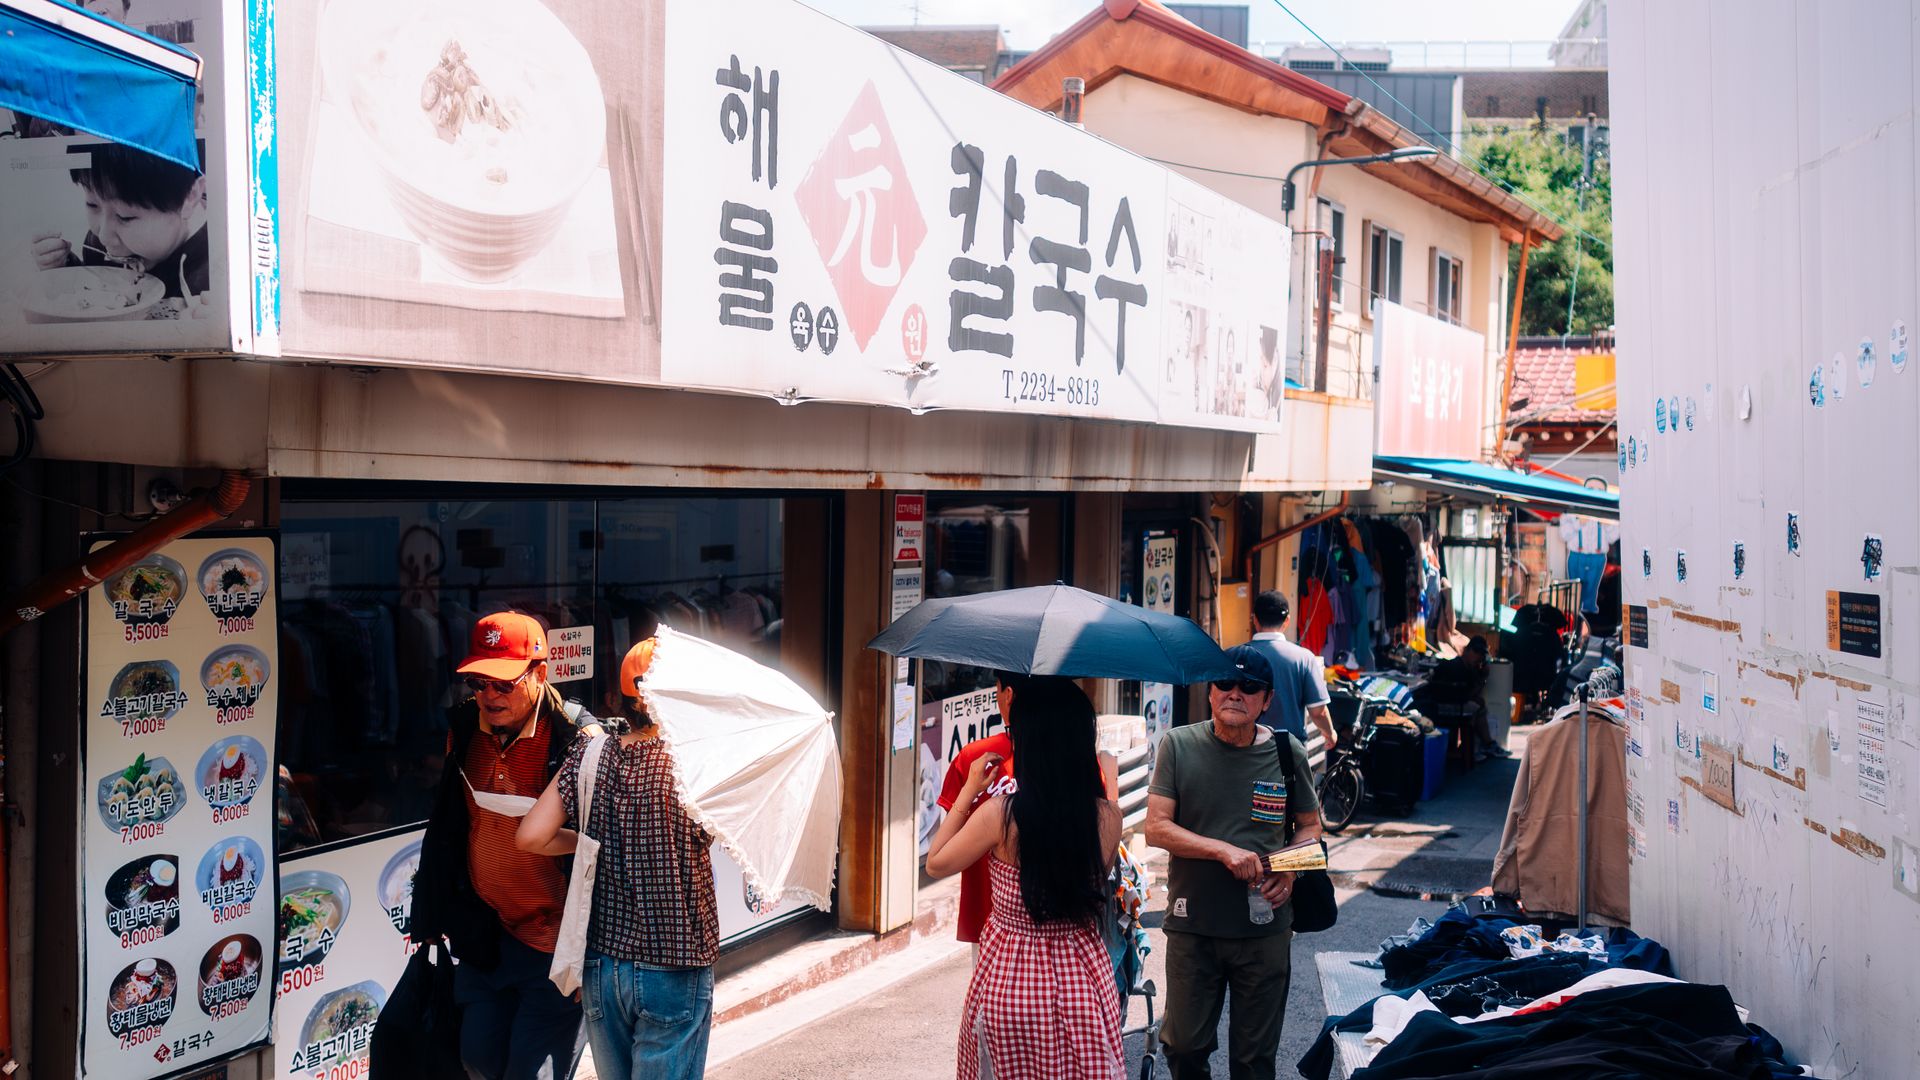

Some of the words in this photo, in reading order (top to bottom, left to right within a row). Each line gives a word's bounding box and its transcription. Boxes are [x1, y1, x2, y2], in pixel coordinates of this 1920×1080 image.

[715, 54, 780, 331] 해물
[948, 141, 1148, 375] 칼국수
[114, 598, 176, 619] 칼국수
[207, 591, 260, 612] 떡만두국
[125, 624, 169, 644] 5,500원
[217, 618, 254, 636] 7,000원
[101, 691, 188, 717] 소불고기칼국수
[207, 683, 260, 708] 손수제비
[216, 706, 254, 725] 6,000원
[122, 719, 165, 739] 7,000원
[204, 778, 257, 804] 냉칼국수
[109, 793, 173, 820] 이도만두
[213, 804, 249, 824] 6,000원
[121, 823, 164, 844] 7,000원
[202, 880, 255, 905] 비빔칼국수
[110, 899, 180, 929] 비빔막국수
[213, 903, 250, 924] 6,000원
[121, 926, 164, 950] 8,000원
[286, 928, 334, 960] 국수
[277, 965, 324, 1000] ,500원
[111, 998, 171, 1032] 황태물냉면
[211, 1000, 248, 1022] 7,500원
[120, 1027, 162, 1051] 7,500원
[173, 1030, 215, 1058] 칼국수
[290, 1020, 376, 1074] 소불고기칼
